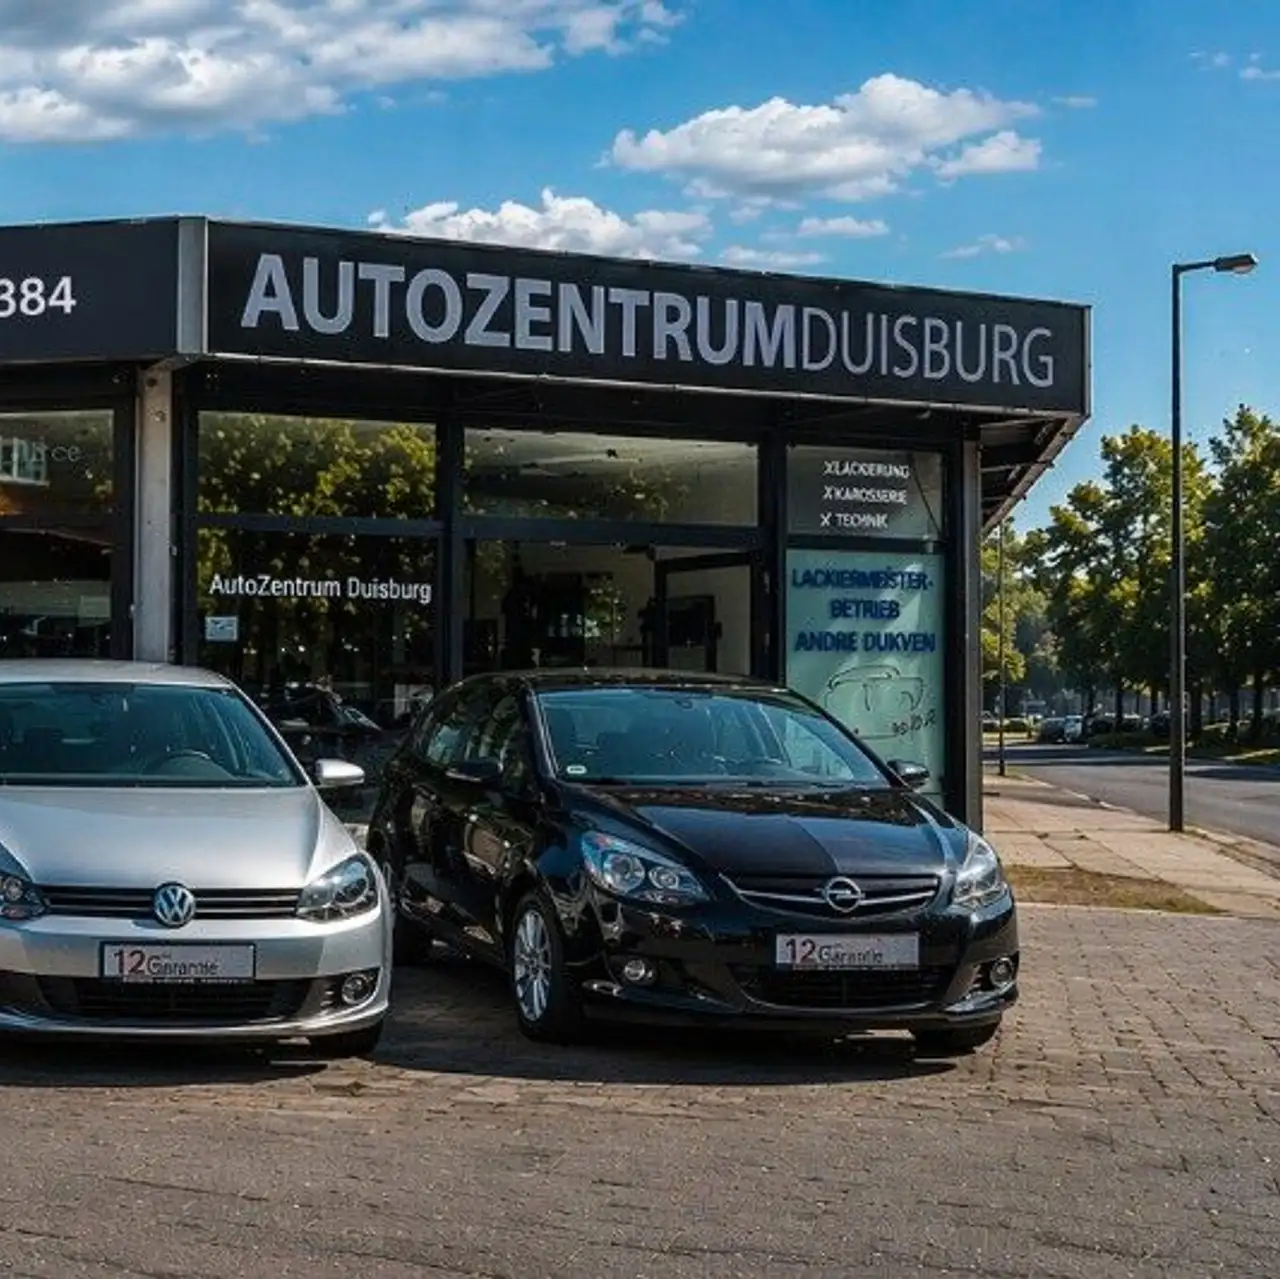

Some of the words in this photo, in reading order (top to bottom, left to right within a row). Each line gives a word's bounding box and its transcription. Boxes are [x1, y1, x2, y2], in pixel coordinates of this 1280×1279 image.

[209, 573, 341, 597] AutoZentrum
[347, 576, 433, 604] Duisburg
[830, 599, 901, 620] BETRIEB
[114, 949, 146, 974] 12
[785, 938, 816, 963] 12
